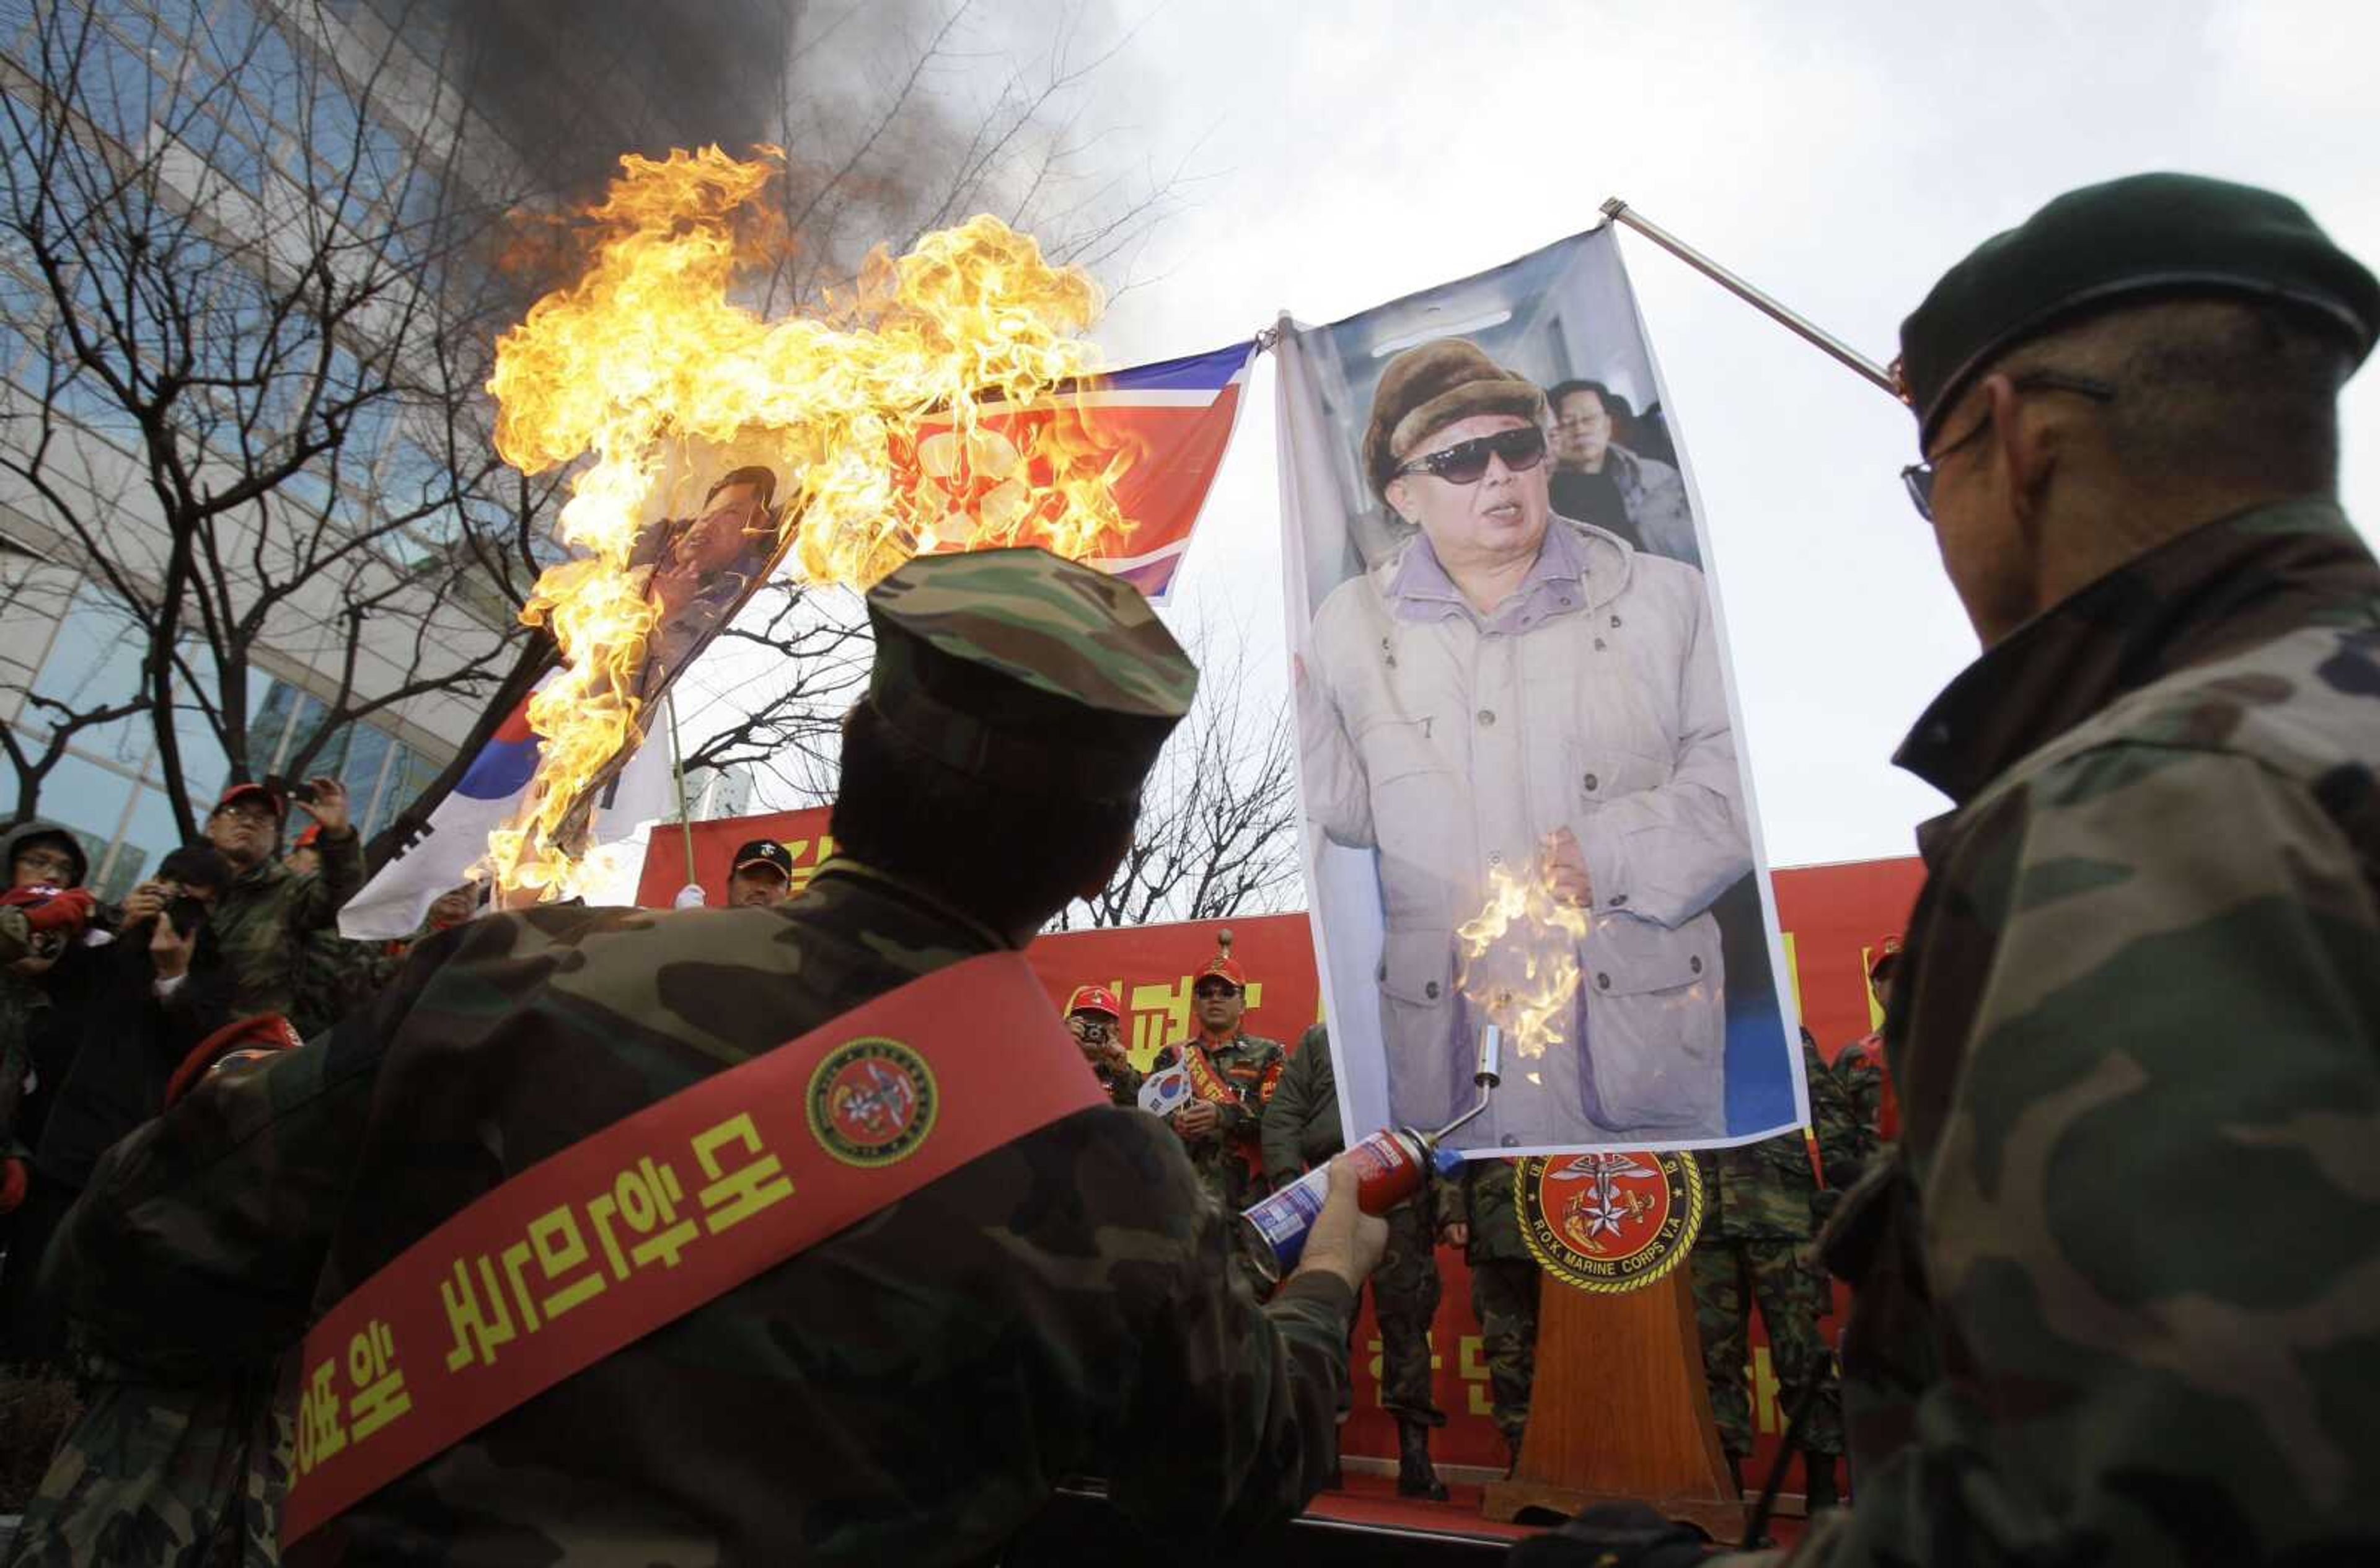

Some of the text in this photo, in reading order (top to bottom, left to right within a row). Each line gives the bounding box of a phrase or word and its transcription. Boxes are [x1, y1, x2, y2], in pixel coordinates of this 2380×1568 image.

[287, 1112, 796, 1490] 대한민국 해병
[1563, 1252, 1616, 1275] MARINE
[1621, 1241, 1666, 1273] CORPS
